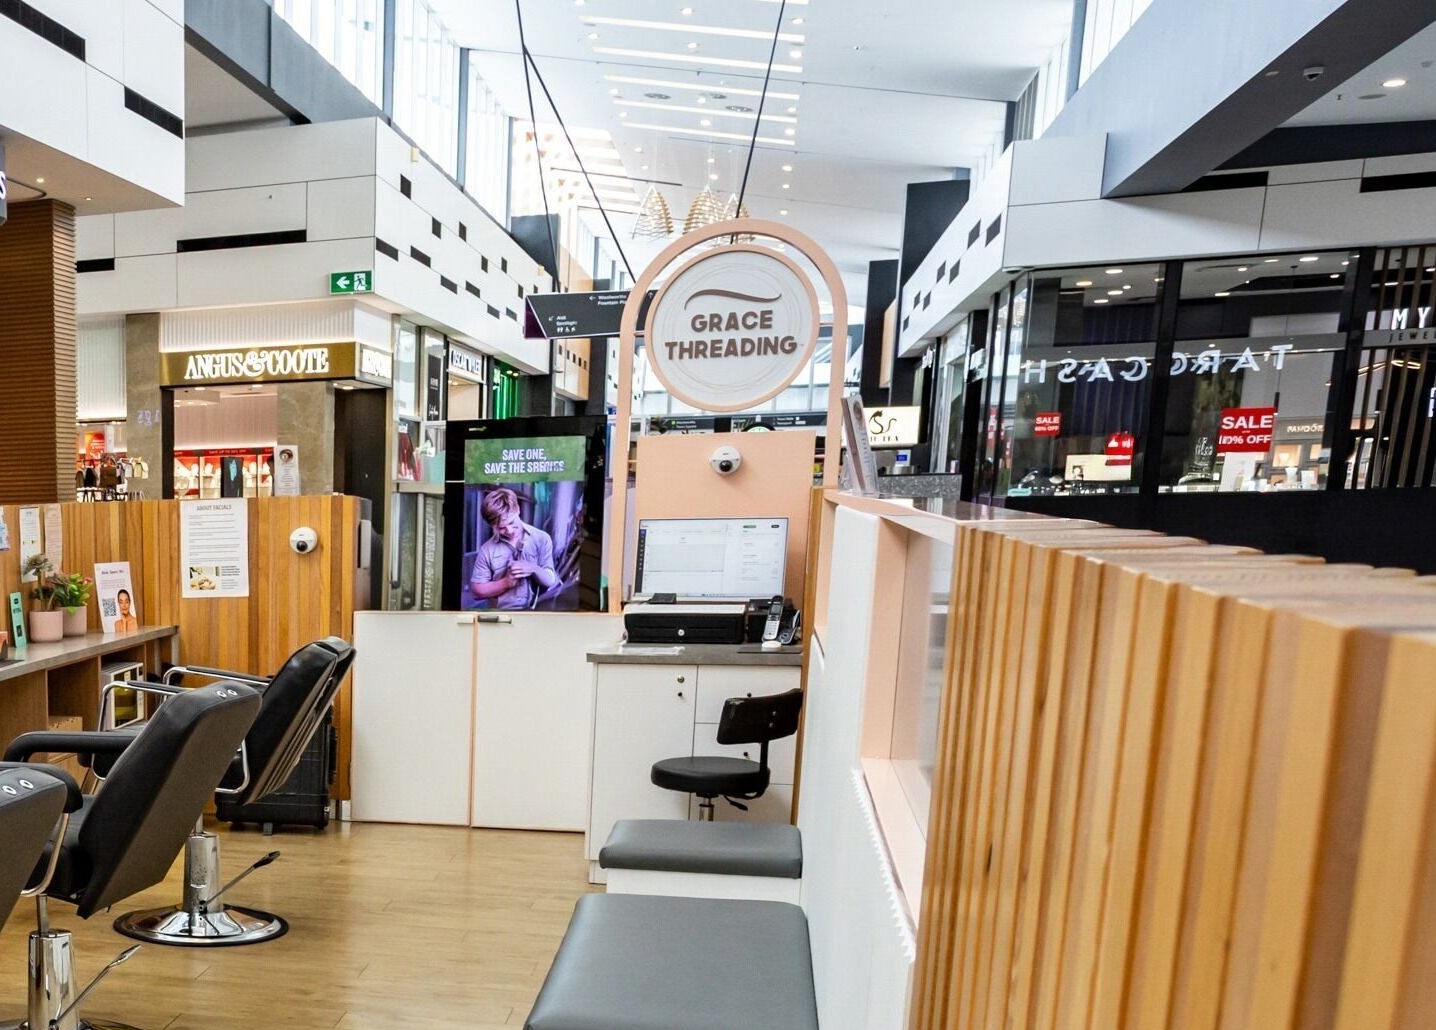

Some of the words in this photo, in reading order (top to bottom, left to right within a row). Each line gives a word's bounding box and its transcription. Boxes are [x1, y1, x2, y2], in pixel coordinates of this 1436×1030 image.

[690, 309, 773, 333] GRACE
[1390, 306, 1432, 331] MY
[1389, 331, 1436, 343] JEWE
[664, 335, 797, 361] THREADING
[1035, 416, 1060, 424] SALE
[1221, 414, 1274, 430] SALE
[1246, 434, 1272, 444] OFF
[502, 449, 525, 461] SAVE
[525, 448, 548, 461] ONE,
[484, 462, 507, 475] SAVE
[508, 462, 526, 473] THE
